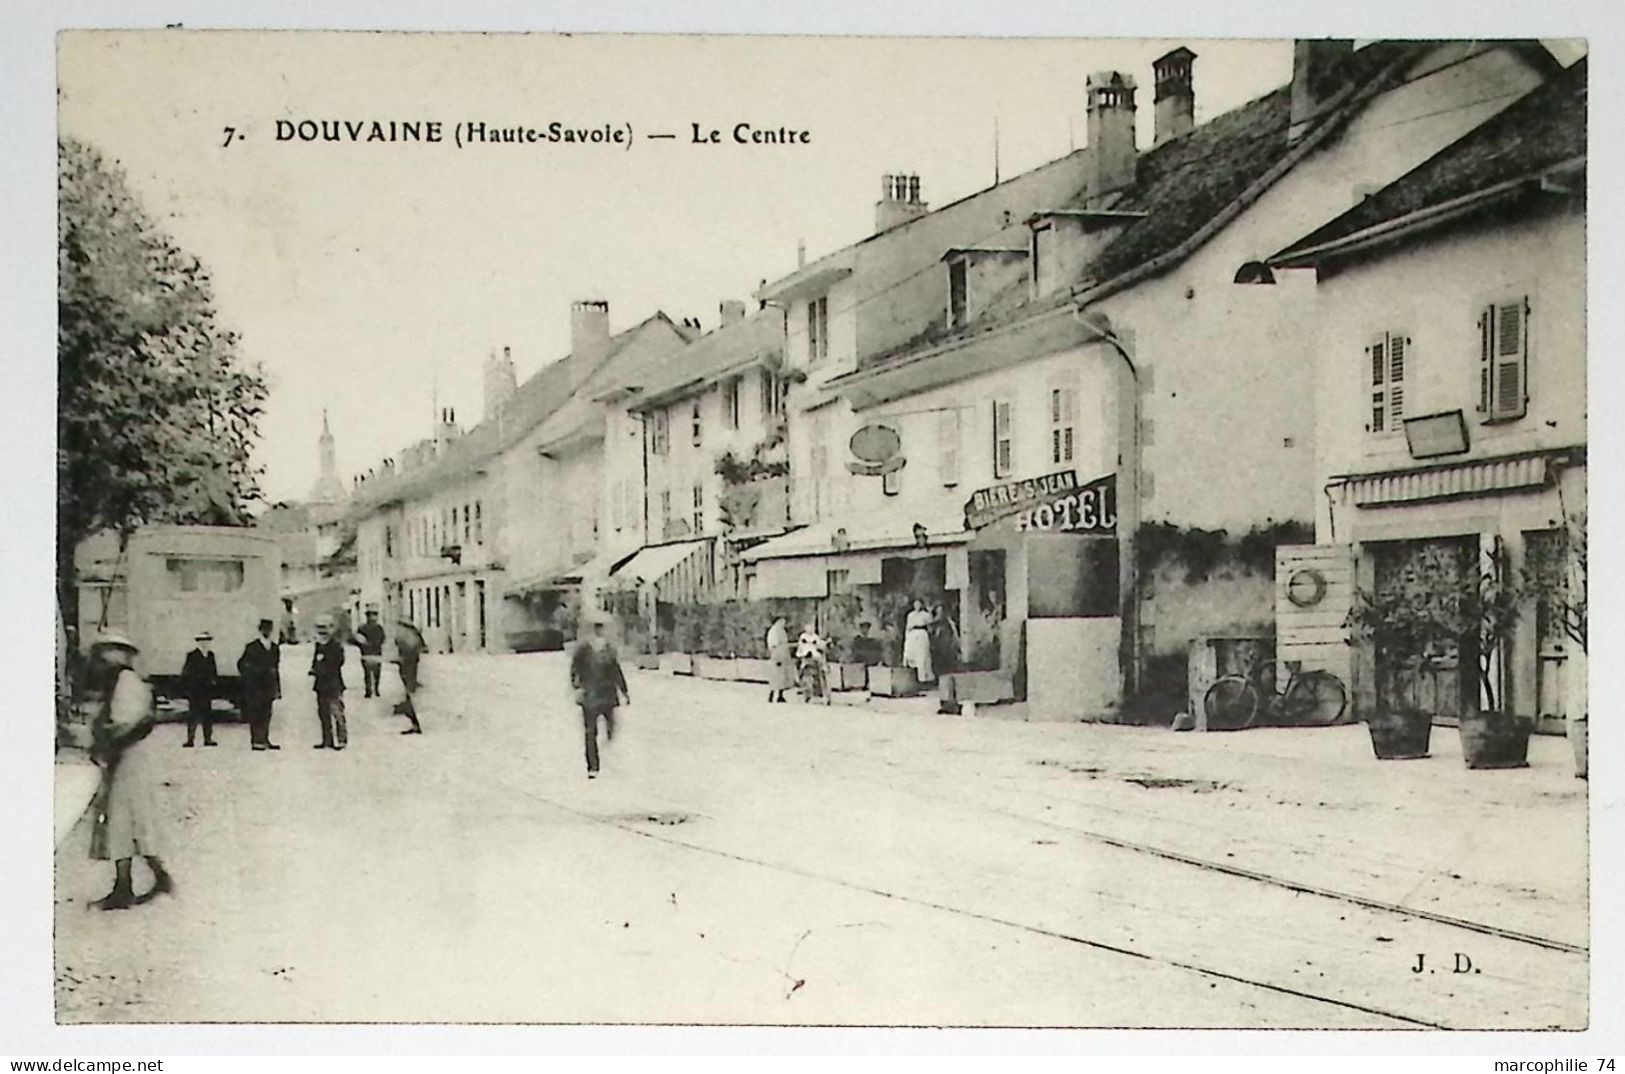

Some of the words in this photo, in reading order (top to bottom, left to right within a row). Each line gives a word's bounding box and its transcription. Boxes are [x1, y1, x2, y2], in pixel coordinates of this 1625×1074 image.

[222, 126, 246, 148] 7.
[275, 119, 443, 143] DOUVAINE
[454, 121, 633, 151] (Haute-Savoie)
[691, 122, 721, 144] Le
[733, 122, 811, 144] Centre
[1015, 485, 1117, 532] HOTEL
[1411, 953, 1435, 974] J.
[1452, 952, 1482, 975] D.
